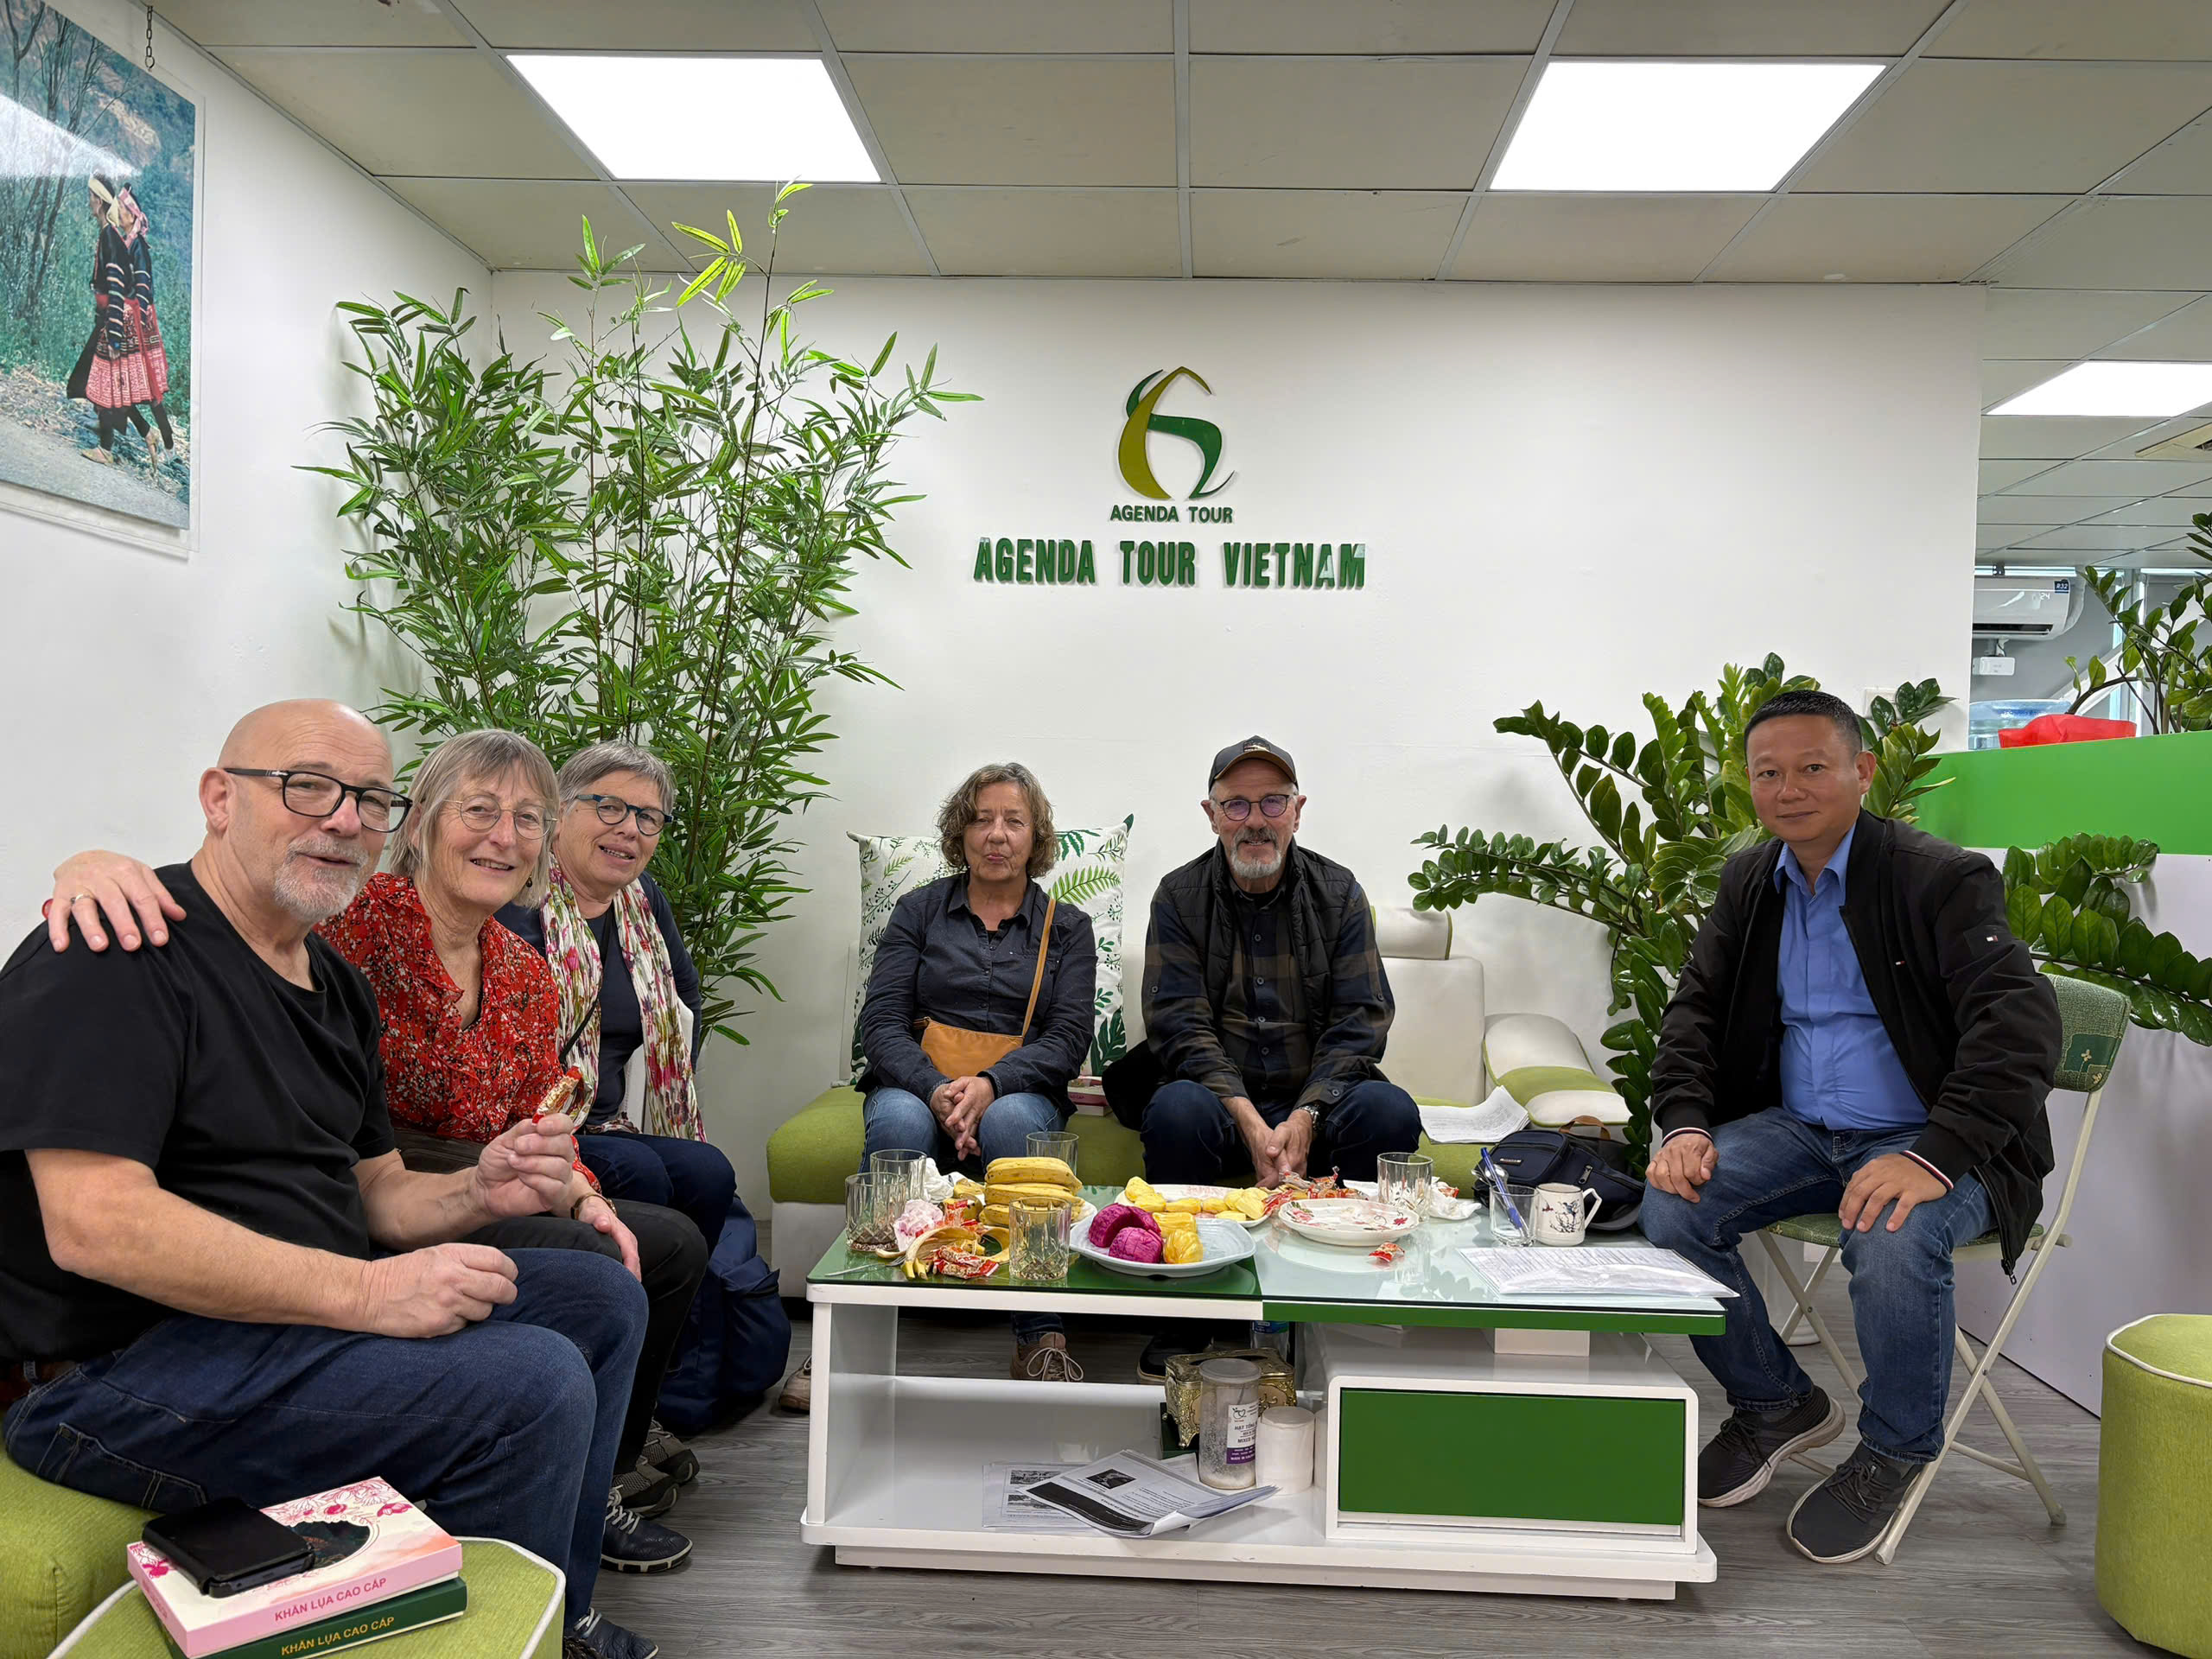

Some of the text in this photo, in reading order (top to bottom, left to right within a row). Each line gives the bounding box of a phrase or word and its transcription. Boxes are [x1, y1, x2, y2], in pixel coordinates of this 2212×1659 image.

[1110, 505, 1233, 524] AGENDA TOUR
[973, 537, 1365, 588] AGENDA TOUR VIETNAM
[2040, 592, 2050, 601] 24
[336, 1586, 361, 1601] CAO
[343, 1624, 369, 1638] CAO
